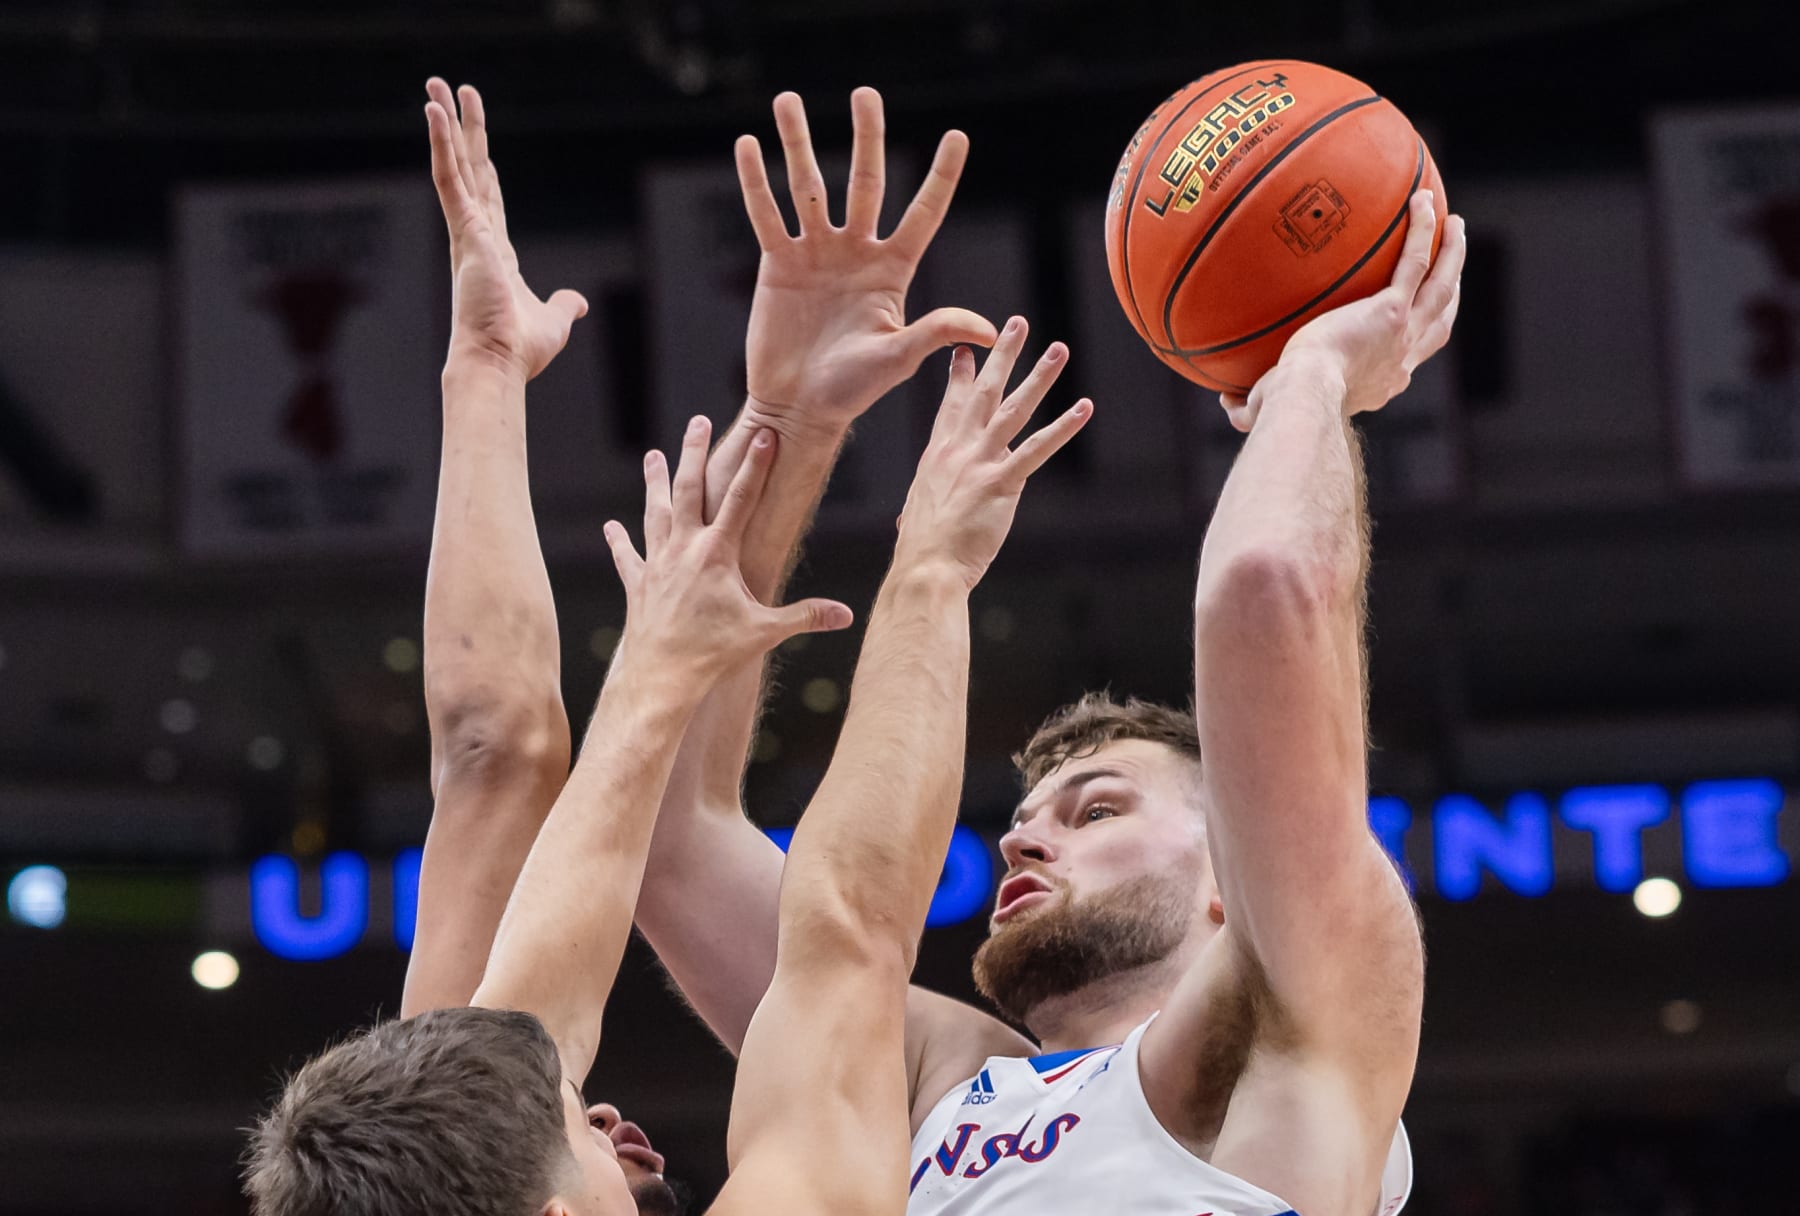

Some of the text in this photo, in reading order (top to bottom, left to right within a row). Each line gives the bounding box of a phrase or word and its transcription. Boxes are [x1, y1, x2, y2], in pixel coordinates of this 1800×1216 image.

[1144, 73, 1288, 218] LEGACY
[1199, 92, 1296, 177] 1000
[1208, 154, 1242, 192] OFFICIAL
[1239, 134, 1264, 156] GAME
